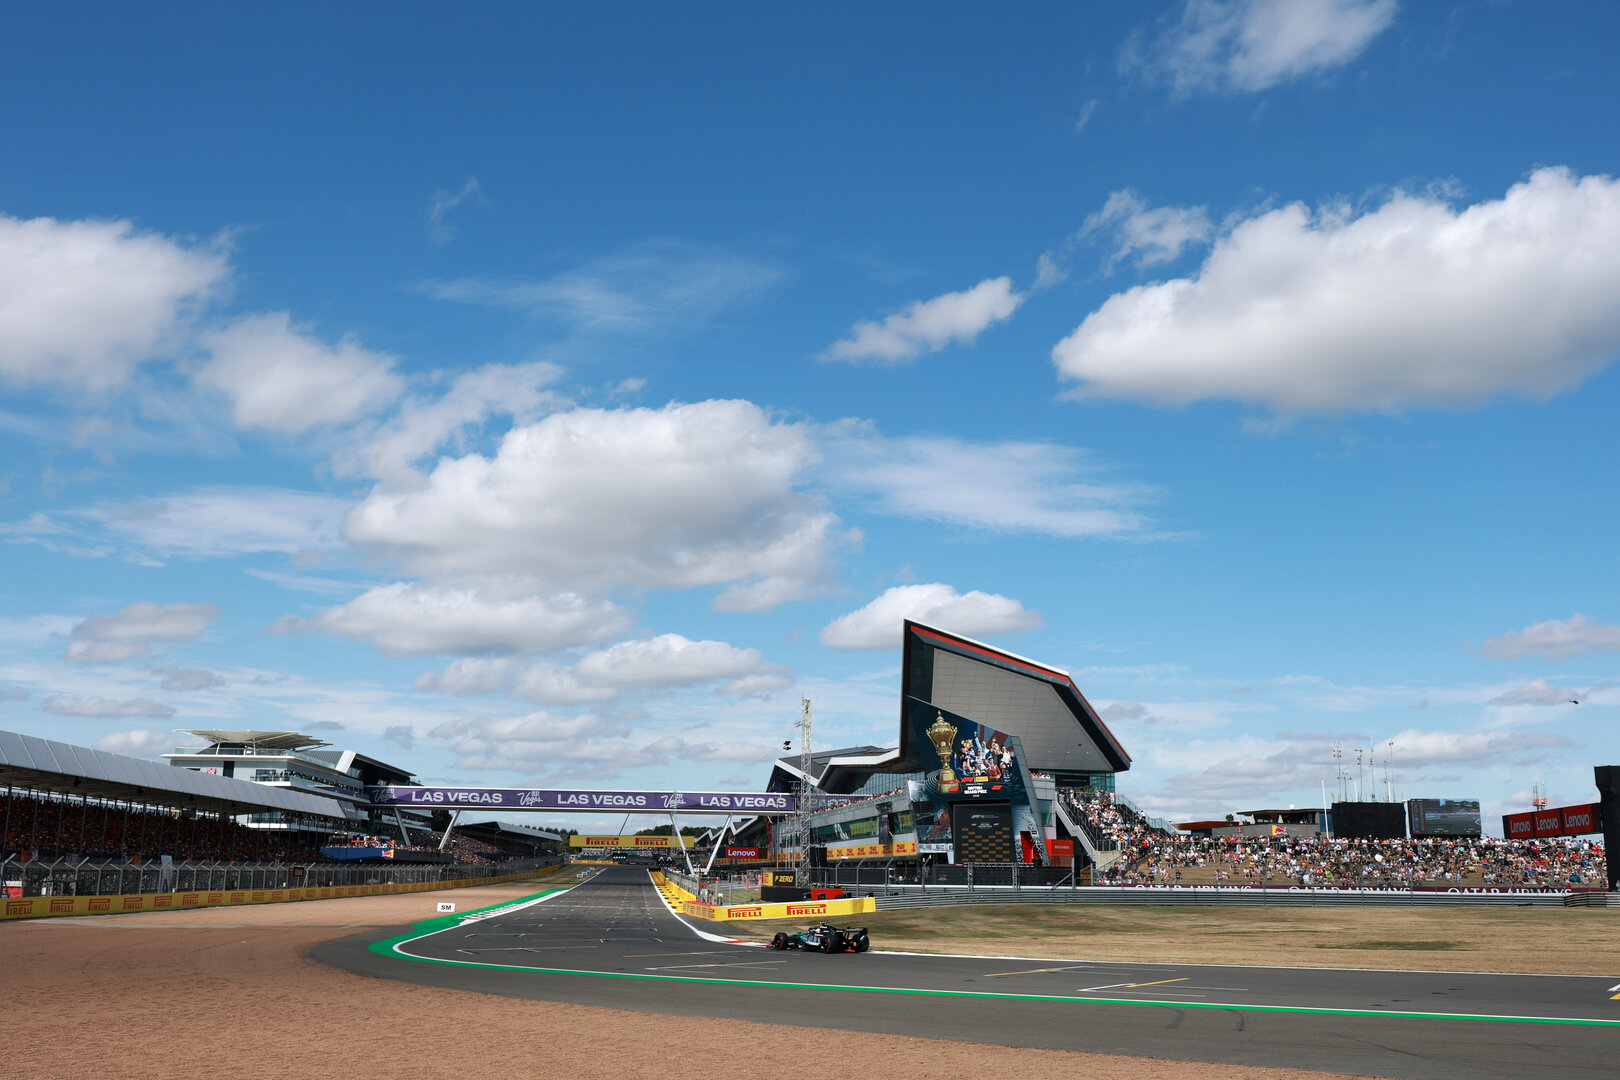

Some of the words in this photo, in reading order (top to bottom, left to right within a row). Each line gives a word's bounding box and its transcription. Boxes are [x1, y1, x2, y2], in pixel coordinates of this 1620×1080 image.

[411, 791, 444, 802] LAS
[447, 792, 503, 803] VEGAS
[517, 791, 543, 806] Vegas
[557, 794, 590, 804] LAS
[592, 795, 647, 806] VEGAS
[700, 796, 731, 807] LAS
[733, 797, 787, 808] VEGAS
[1510, 820, 1531, 833] Lenovo
[1535, 816, 1559, 831] Lenovo
[1564, 813, 1590, 828] Lenovo
[586, 837, 619, 845] PIRELLI
[635, 837, 668, 845] PIRELLI
[6, 901, 33, 915] PIRELLI
[50, 899, 74, 912] PIRELLI
[88, 898, 111, 911] PIRELLI
[123, 897, 143, 909] PIRELLI
[786, 904, 826, 915] PIRELLI
[728, 907, 762, 918] PIRELLI
